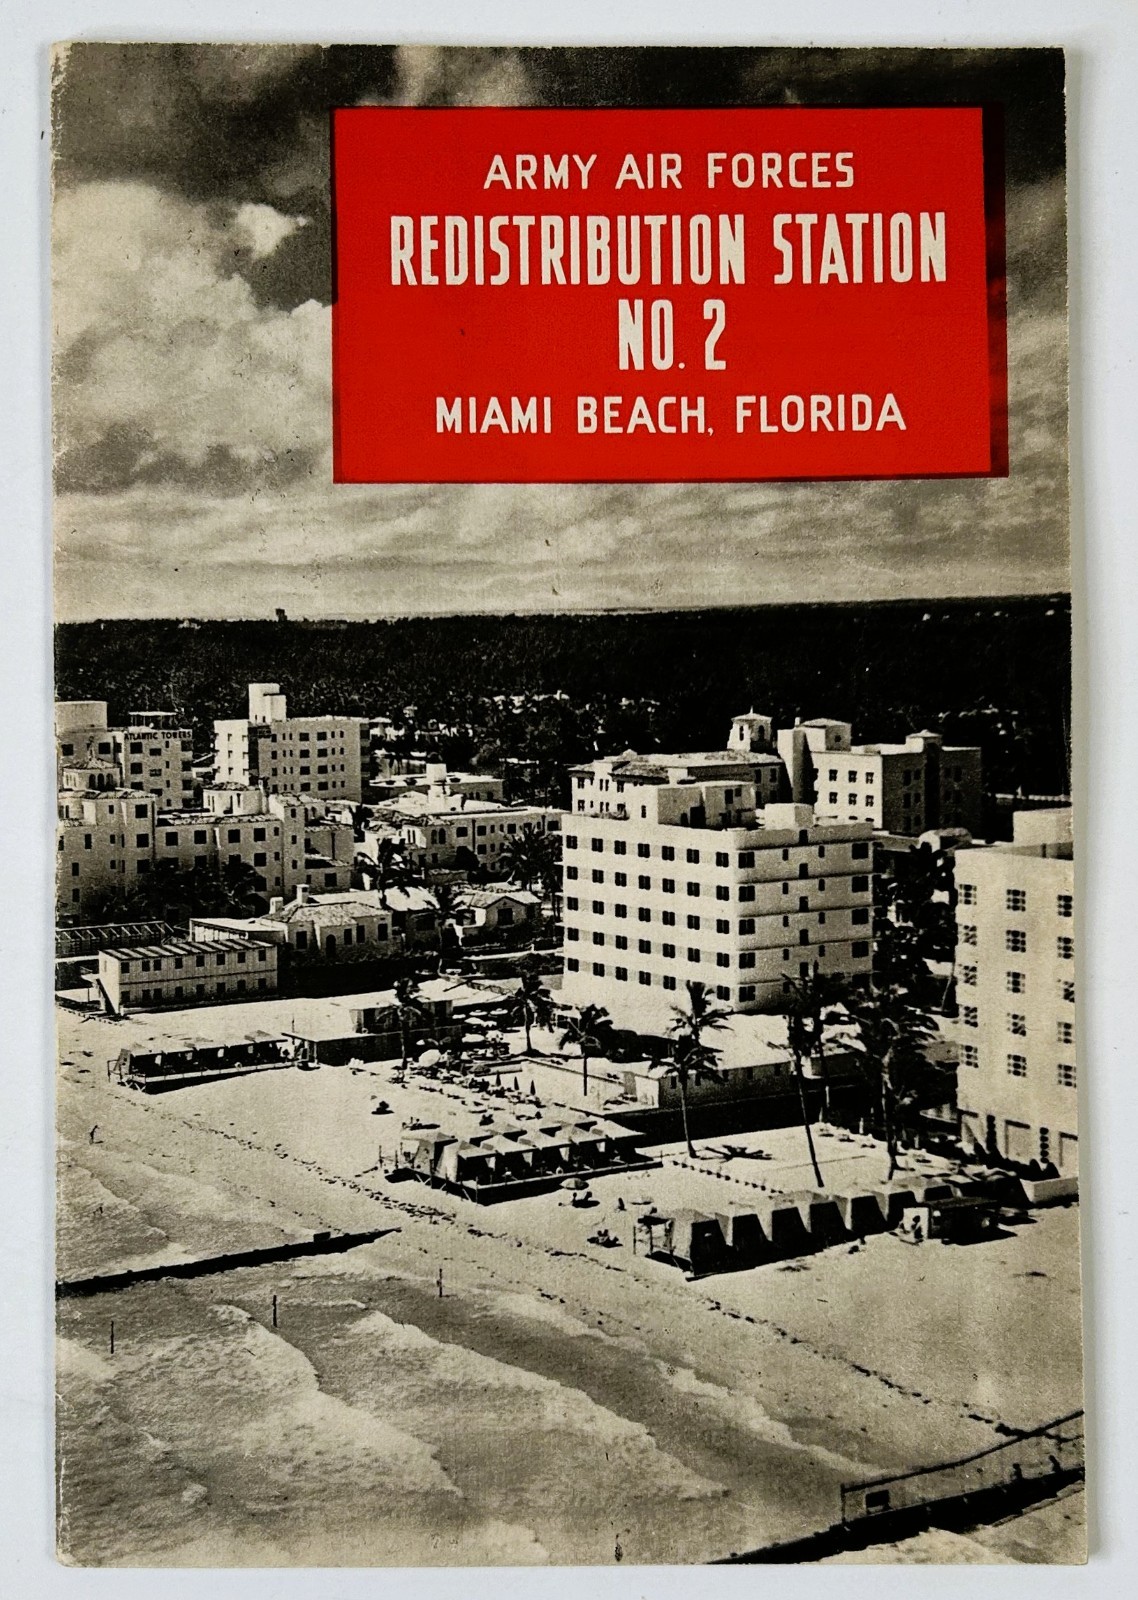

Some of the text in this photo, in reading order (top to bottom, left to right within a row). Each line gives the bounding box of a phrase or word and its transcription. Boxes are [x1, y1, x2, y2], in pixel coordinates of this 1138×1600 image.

[483, 152, 855, 190] ARMY AIR FORCES
[390, 211, 947, 286] REDISTRIBUTION STATION
[618, 298, 727, 371] NO. 2
[435, 393, 907, 436] MIAMI BEACH, FLORIDA
[124, 731, 191, 740] ATLANTIC TOWERS
